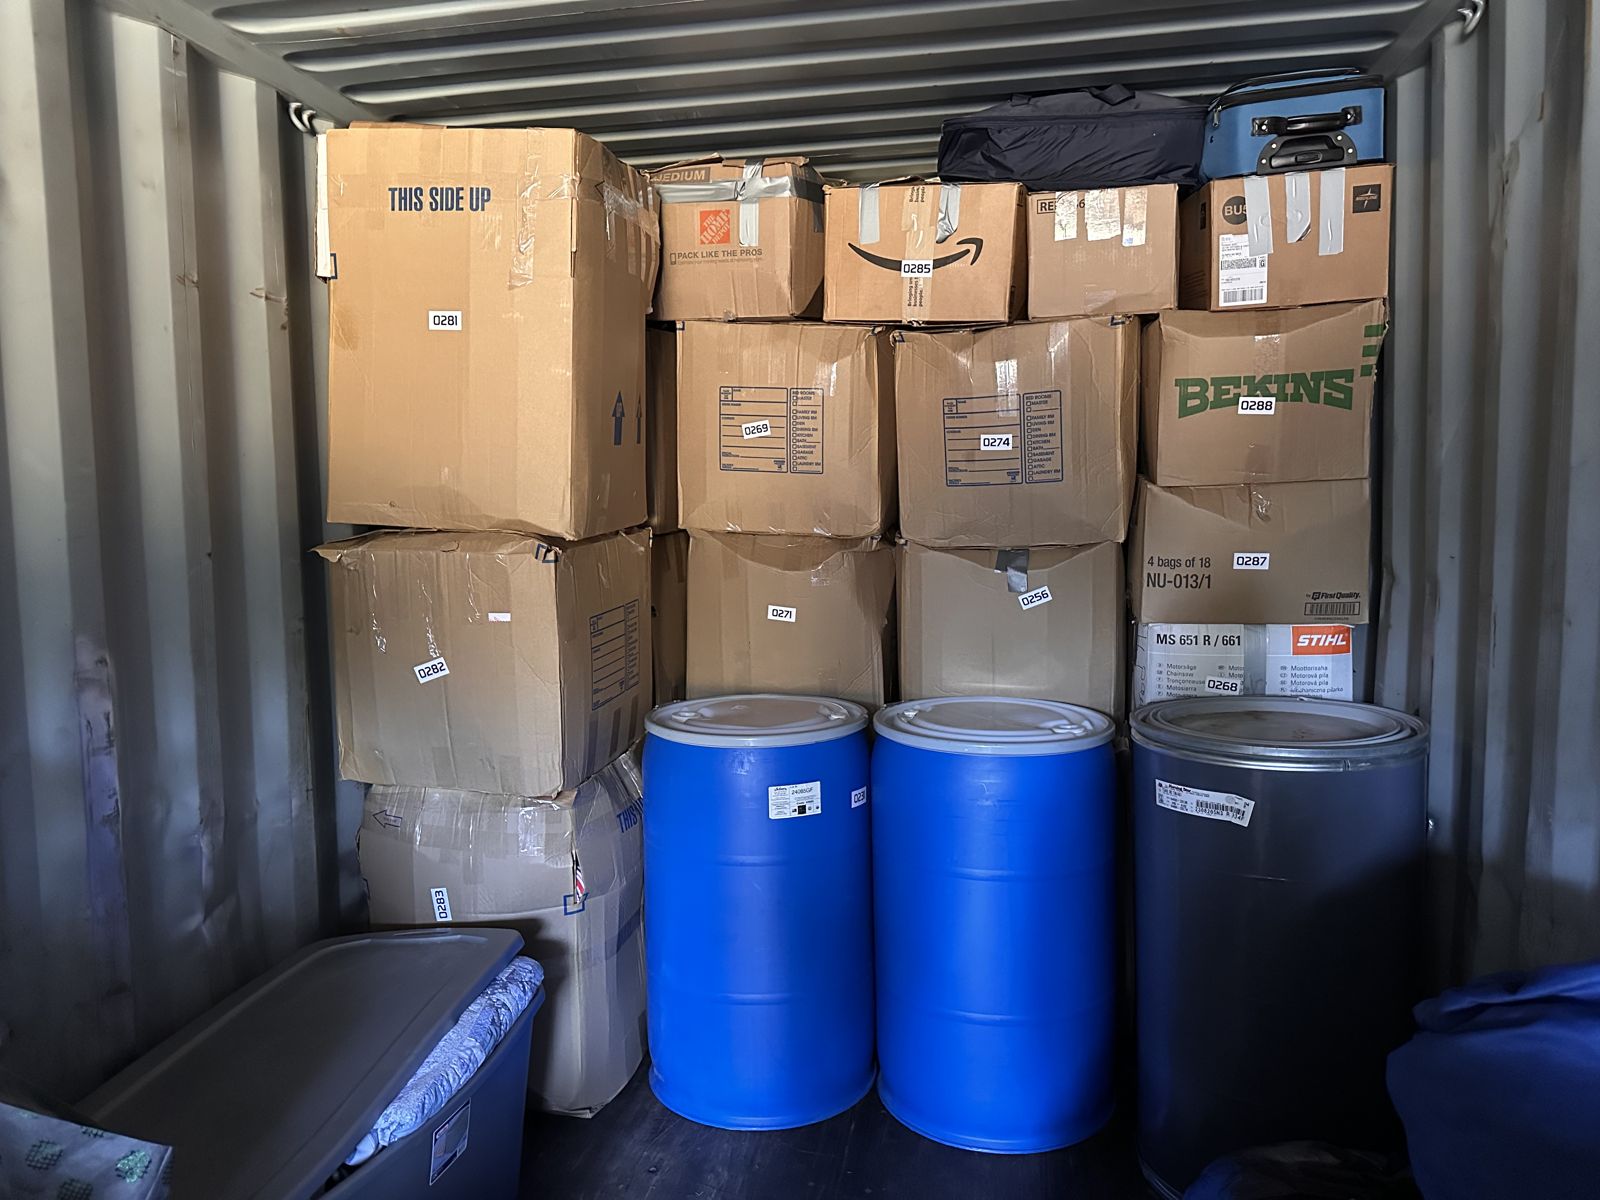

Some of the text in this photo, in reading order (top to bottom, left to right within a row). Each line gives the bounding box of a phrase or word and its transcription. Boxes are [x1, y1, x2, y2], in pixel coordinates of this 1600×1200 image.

[388, 187, 491, 211] THIS SIDE UP
[700, 209, 730, 244] HOME
[677, 248, 762, 259] PACK LIKE THE PROS
[903, 263, 931, 274] 0285
[433, 315, 458, 326] 0281
[1175, 368, 1354, 419] BEKINS
[1240, 400, 1273, 411] 0288
[744, 423, 769, 436] 0269
[983, 437, 1010, 447] 0274
[1147, 556, 1211, 569] 4 bags of 18
[1236, 556, 1267, 566] 0287
[1146, 573, 1212, 589] NU-013/1
[1021, 589, 1049, 607] 0256
[771, 608, 793, 619] 0271
[1156, 633, 1241, 647] MS 651 R / 661
[1297, 634, 1346, 647] STIHL
[418, 661, 446, 679] 0282
[1207, 679, 1238, 692] 0268
[434, 890, 448, 919] 0283
